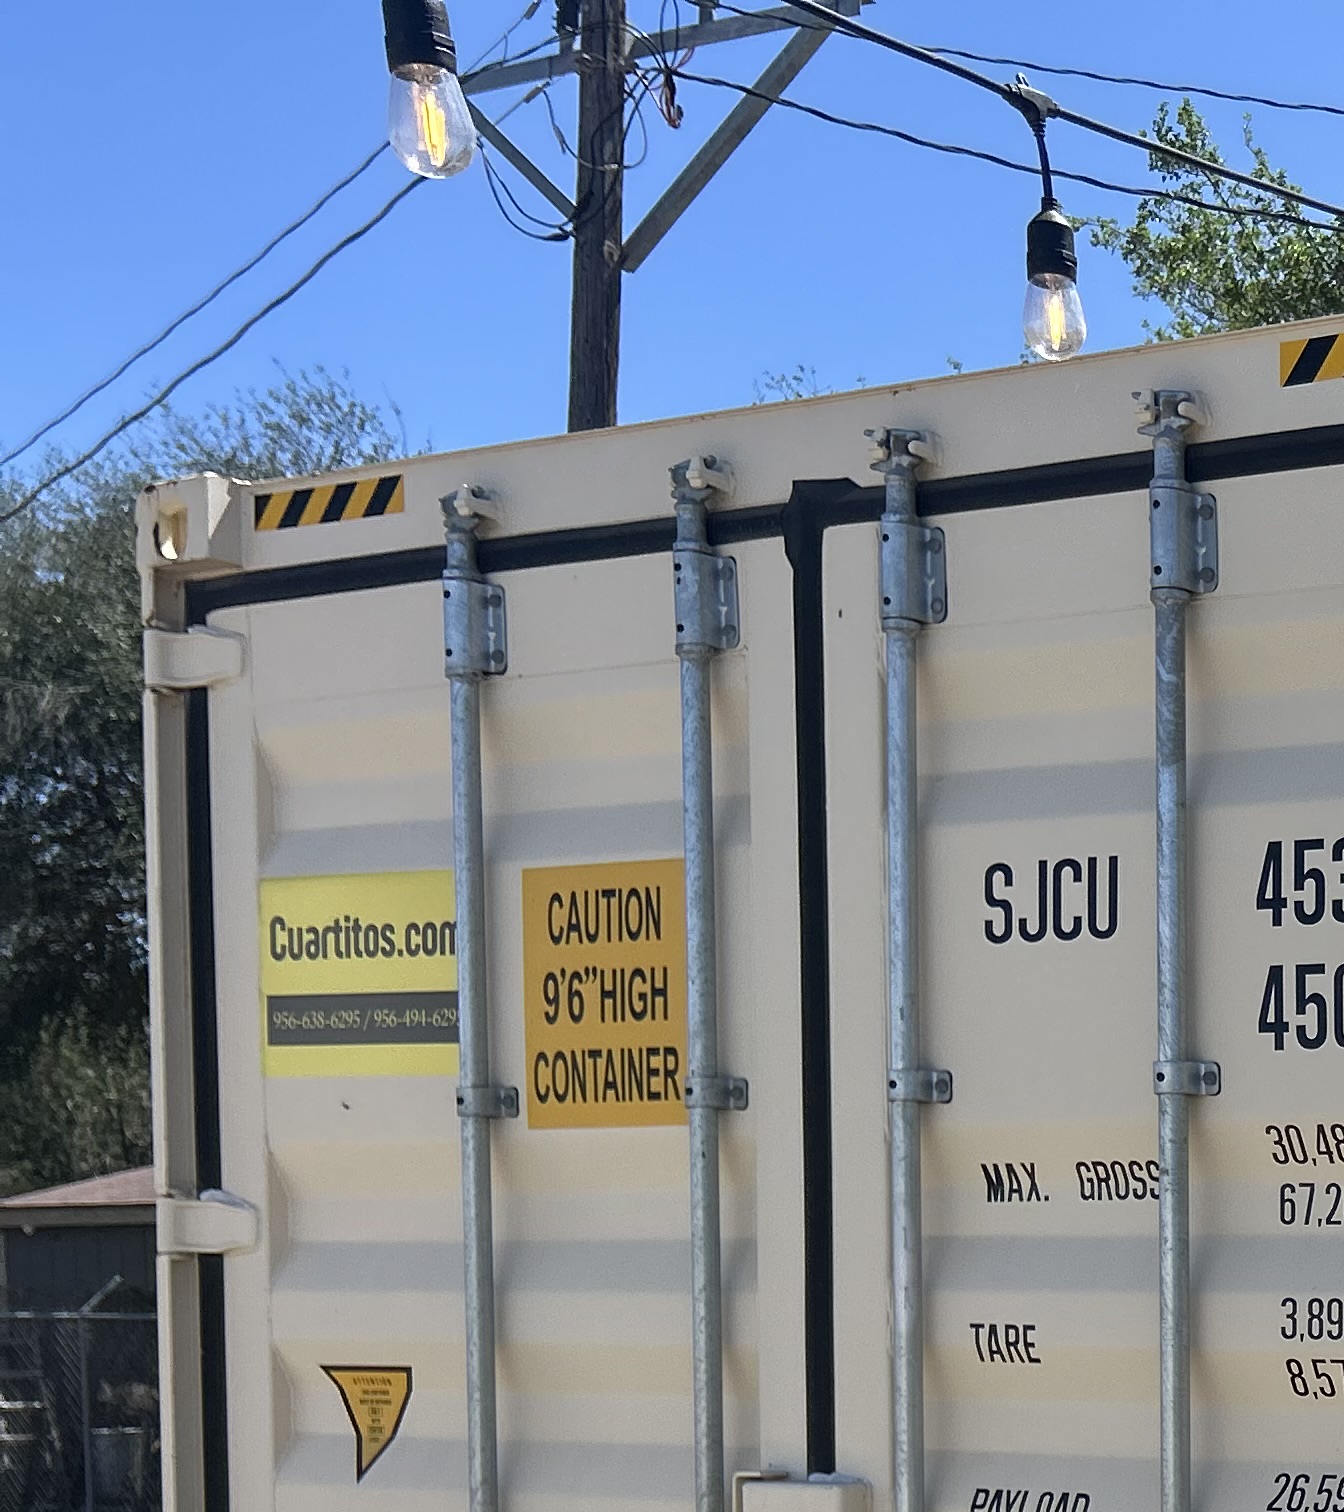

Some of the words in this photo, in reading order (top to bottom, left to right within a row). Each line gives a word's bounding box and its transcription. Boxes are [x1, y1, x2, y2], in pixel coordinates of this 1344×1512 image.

[547, 885, 661, 946] CAUTION
[984, 855, 1119, 945] SJCU
[273, 1011, 361, 1030] 956-638-6295
[373, 1006, 460, 1029] 956-494-629
[533, 1046, 681, 1105] CONTAINER
[980, 1162, 1050, 1203] MAX.
[1075, 1159, 1160, 1202] GROSS
[969, 1322, 1042, 1364] TARE
